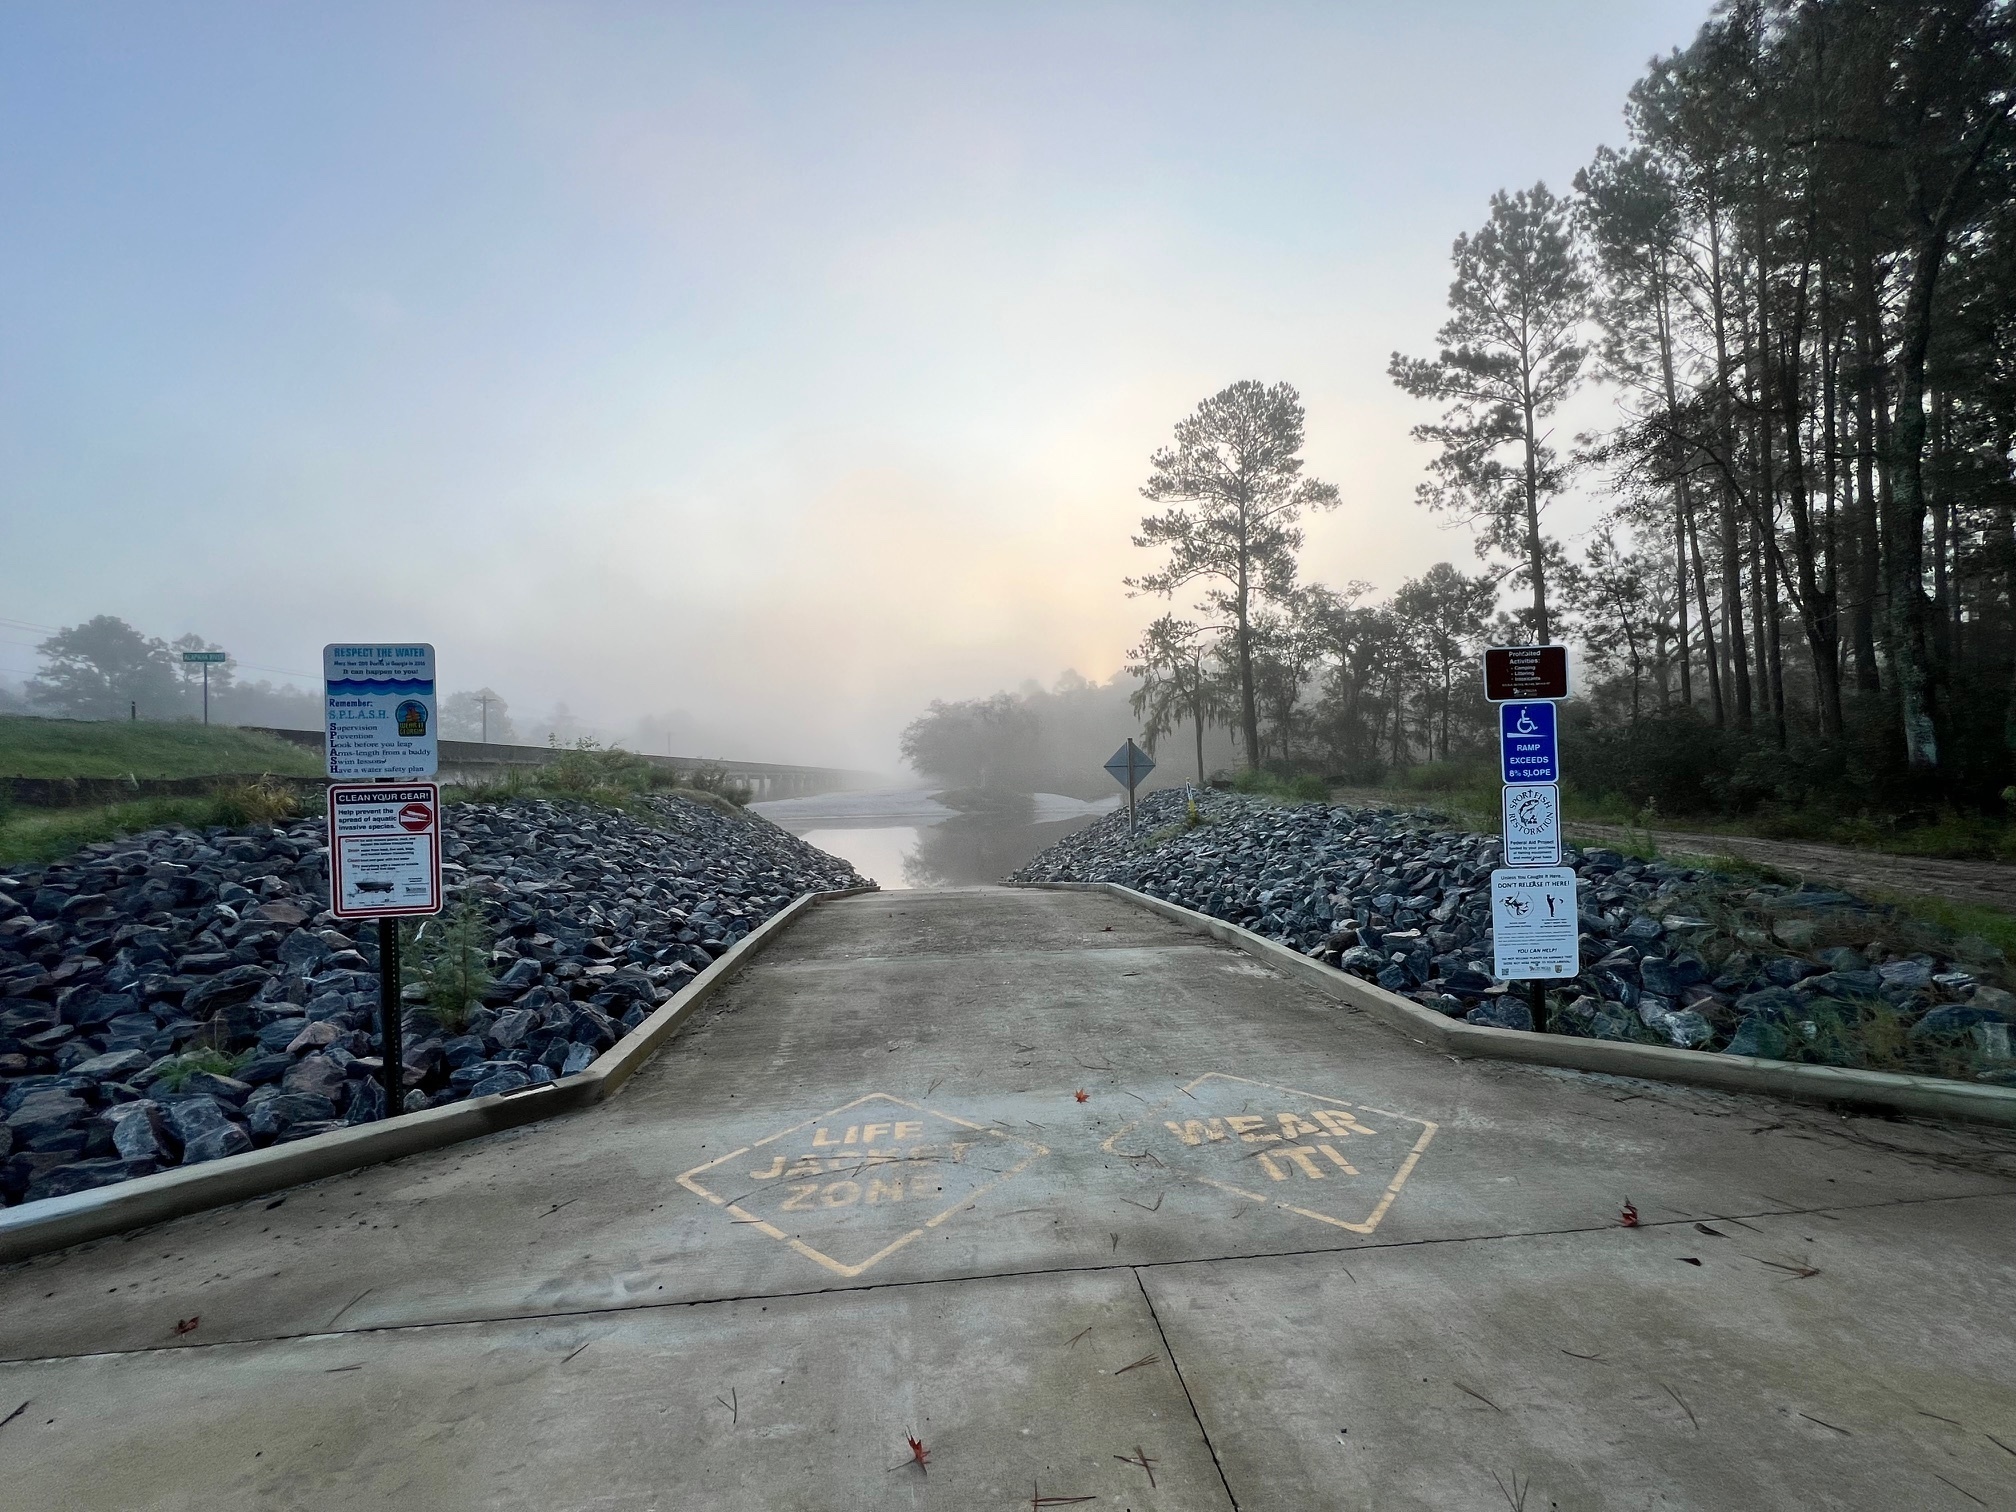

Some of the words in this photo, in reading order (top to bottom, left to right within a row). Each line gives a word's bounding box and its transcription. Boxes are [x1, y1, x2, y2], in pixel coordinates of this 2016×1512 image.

[334, 648, 373, 657] RESPECT
[377, 648, 392, 657] THE
[395, 648, 425, 657] WATER
[329, 699, 373, 707] Remember:
[330, 723, 377, 732] Supervision
[330, 731, 374, 739] Prevention
[330, 740, 352, 748] Look
[330, 749, 380, 757] Arms-length
[330, 757, 355, 765] Swim
[1510, 756, 1549, 764] EXCEEDS
[330, 765, 352, 773] Have
[408, 765, 424, 773] plan
[1509, 769, 1521, 777] 8%
[1523, 768, 1551, 776] SLOPE
[338, 794, 370, 802] CLEAN
[372, 793, 397, 801] YOUR
[400, 792, 429, 800] GEAR!
[1510, 789, 1533, 809] SPORT
[1534, 792, 1552, 809] FISH
[1509, 812, 1553, 835] RESTORATION
[1164, 1110, 1377, 1145] WEAR
[812, 1121, 923, 1146] LIFE
[1259, 1144, 1359, 1181] IT!
[782, 1177, 945, 1211] ZONE
